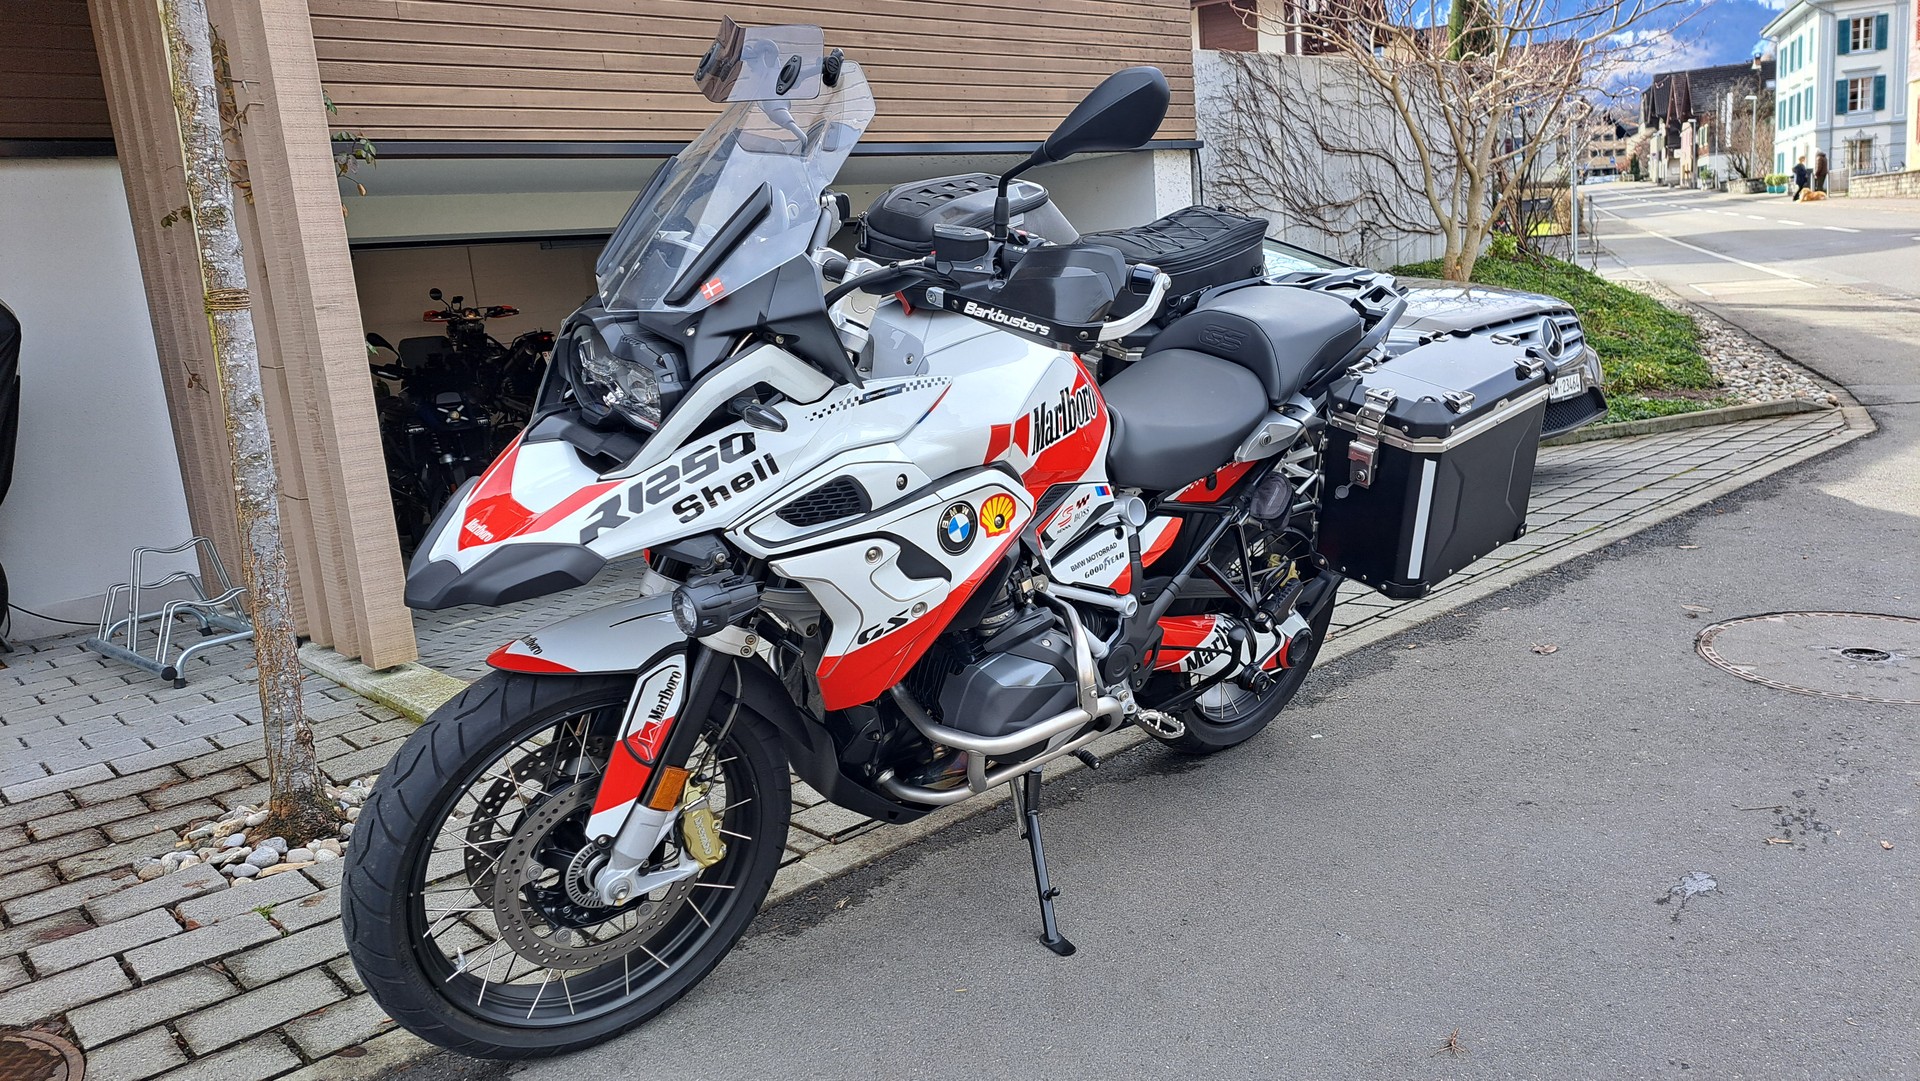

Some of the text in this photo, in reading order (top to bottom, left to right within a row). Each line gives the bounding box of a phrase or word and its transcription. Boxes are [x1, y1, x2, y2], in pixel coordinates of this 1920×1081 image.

[963, 301, 1051, 336] Barkbusters
[1031, 386, 1098, 456] Marlboro
[672, 453, 780, 524] Shell
[464, 518, 494, 542] Marlboro
[941, 505, 970, 529] BMW
[1070, 542, 1118, 572] BMW MOTORRAD
[857, 608, 910, 645] GS
[648, 671, 683, 722] Marlboro
